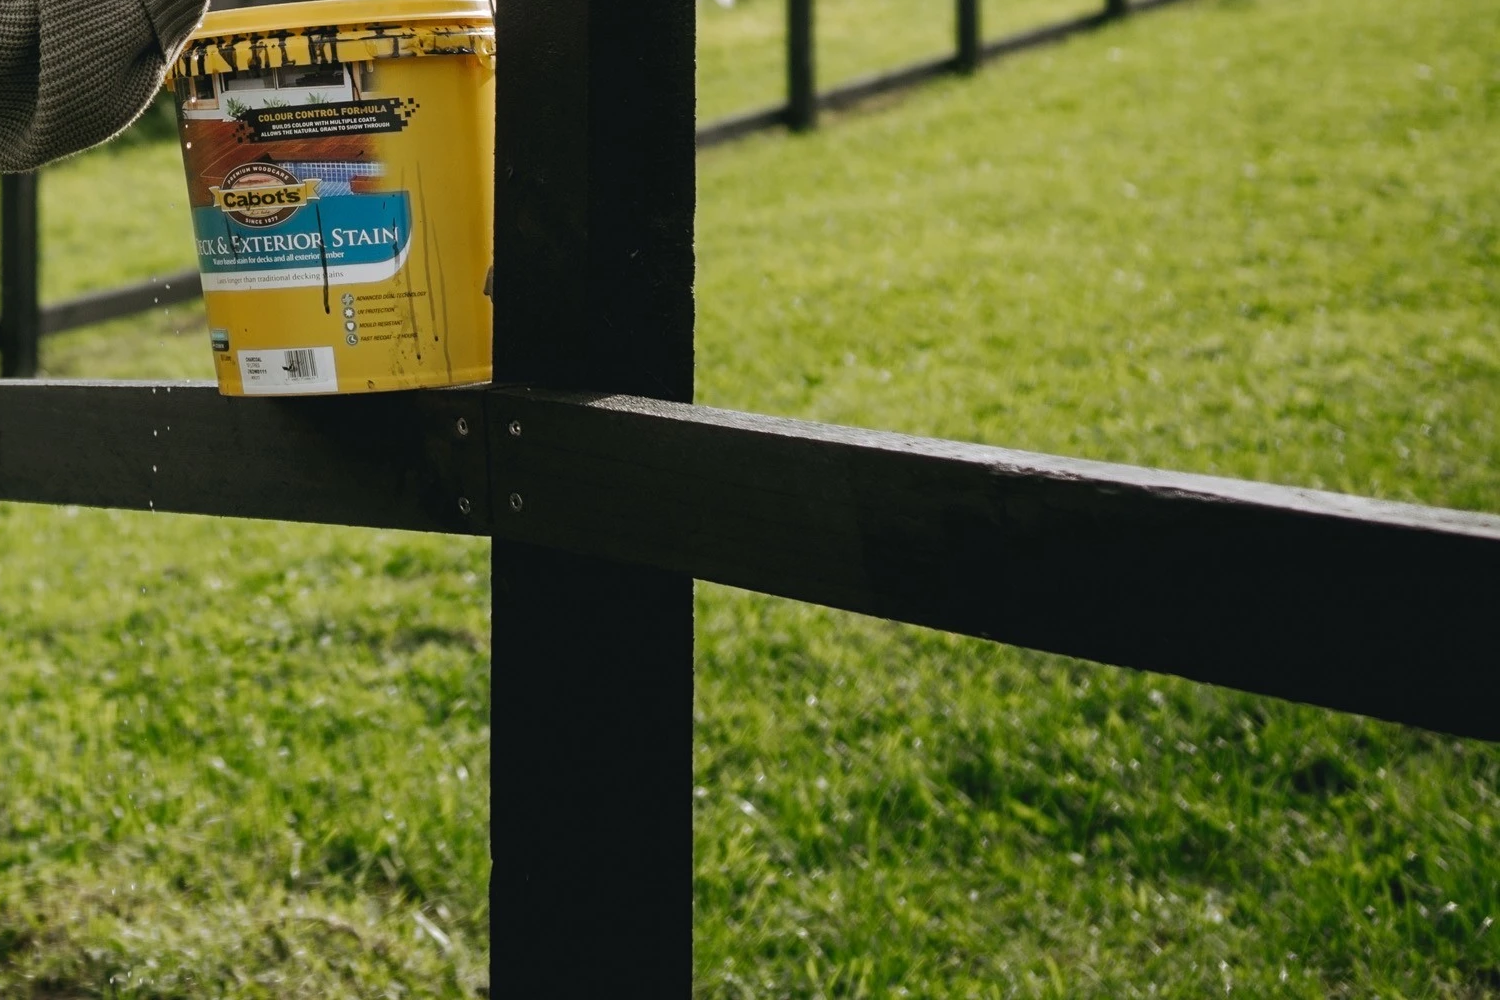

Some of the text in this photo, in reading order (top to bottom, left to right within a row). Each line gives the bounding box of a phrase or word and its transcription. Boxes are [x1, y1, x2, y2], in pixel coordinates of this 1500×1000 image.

[258, 105, 387, 122] COLOUR CONTROL FORMULA
[227, 166, 289, 185] PREMIUM WOODCARE
[223, 188, 301, 207] Cabot's
[197, 226, 399, 256] ECK & EXTERIOR STAIN
[295, 252, 320, 260] exterior
[323, 251, 344, 259] mber
[257, 274, 290, 282] traditional
[292, 272, 321, 281] decking
[323, 271, 344, 279] sains
[356, 293, 382, 301] ADVANCED
